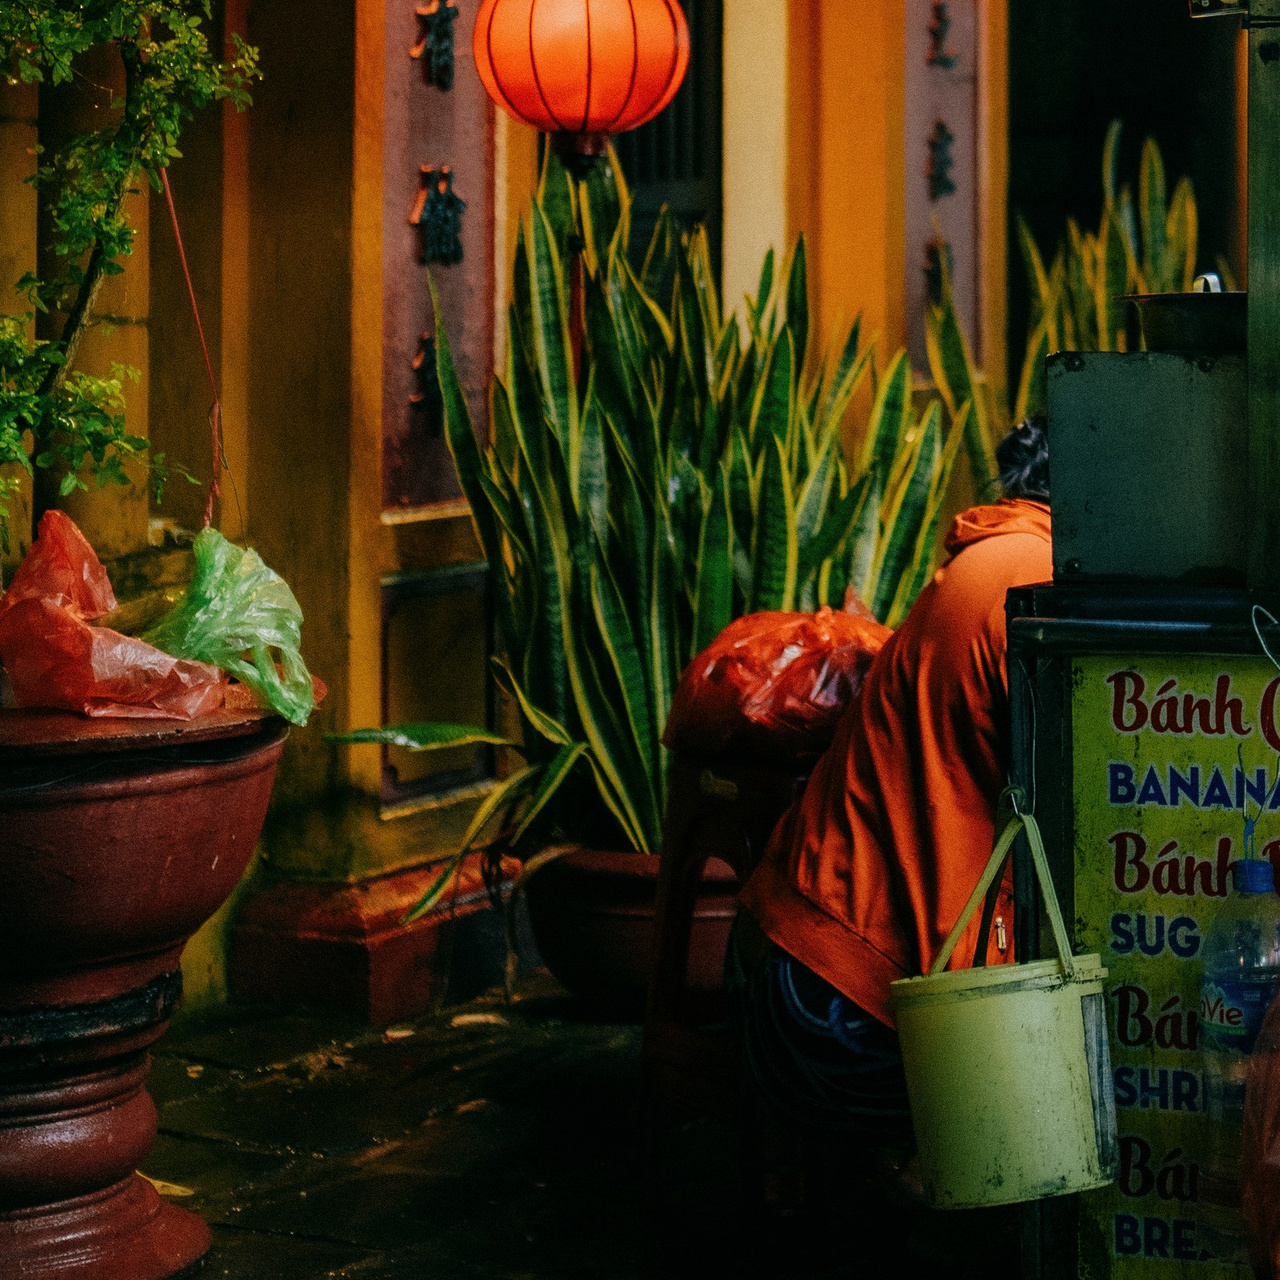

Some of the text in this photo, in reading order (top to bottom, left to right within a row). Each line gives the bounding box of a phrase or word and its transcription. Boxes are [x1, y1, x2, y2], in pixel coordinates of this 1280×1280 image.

[1107, 670, 1252, 736] Bánh
[1110, 913, 1200, 958] SUG
[1201, 994, 1244, 1026] Vie
[1115, 1214, 1203, 1261] BRE
